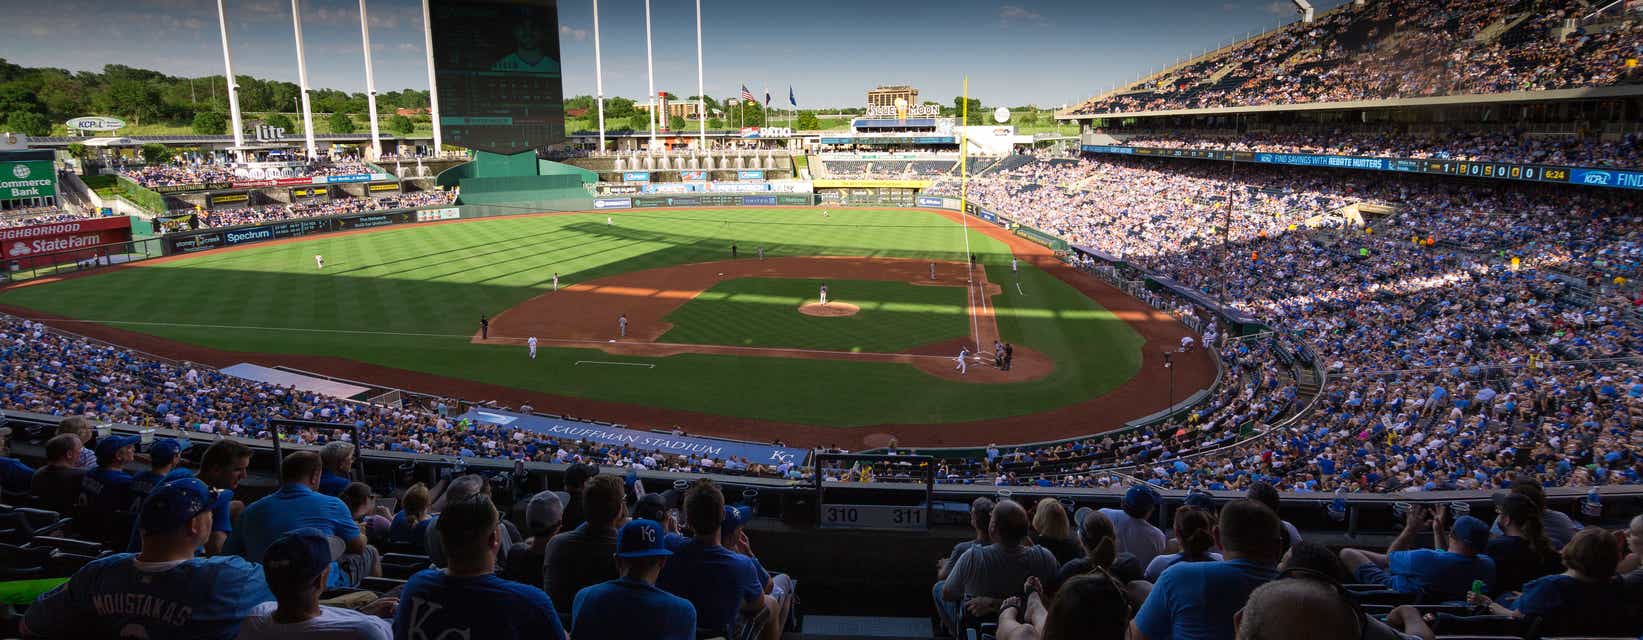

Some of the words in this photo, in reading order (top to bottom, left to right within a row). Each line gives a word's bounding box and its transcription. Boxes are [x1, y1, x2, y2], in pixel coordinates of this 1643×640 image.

[909, 106, 940, 117] MOON
[79, 120, 103, 128] KCPL
[1353, 158, 1382, 169] HUNTERS
[1545, 170, 1565, 179] 6:24
[12, 188, 39, 198] Bank
[227, 230, 270, 243] Spectrum
[549, 424, 639, 443] KAUFFMAN
[641, 437, 721, 456] STADIUM
[768, 450, 794, 464] KC
[827, 508, 858, 522] 310
[893, 508, 921, 523] 311
[641, 525, 656, 543] KC
[92, 593, 193, 625] MOUSTAKAS
